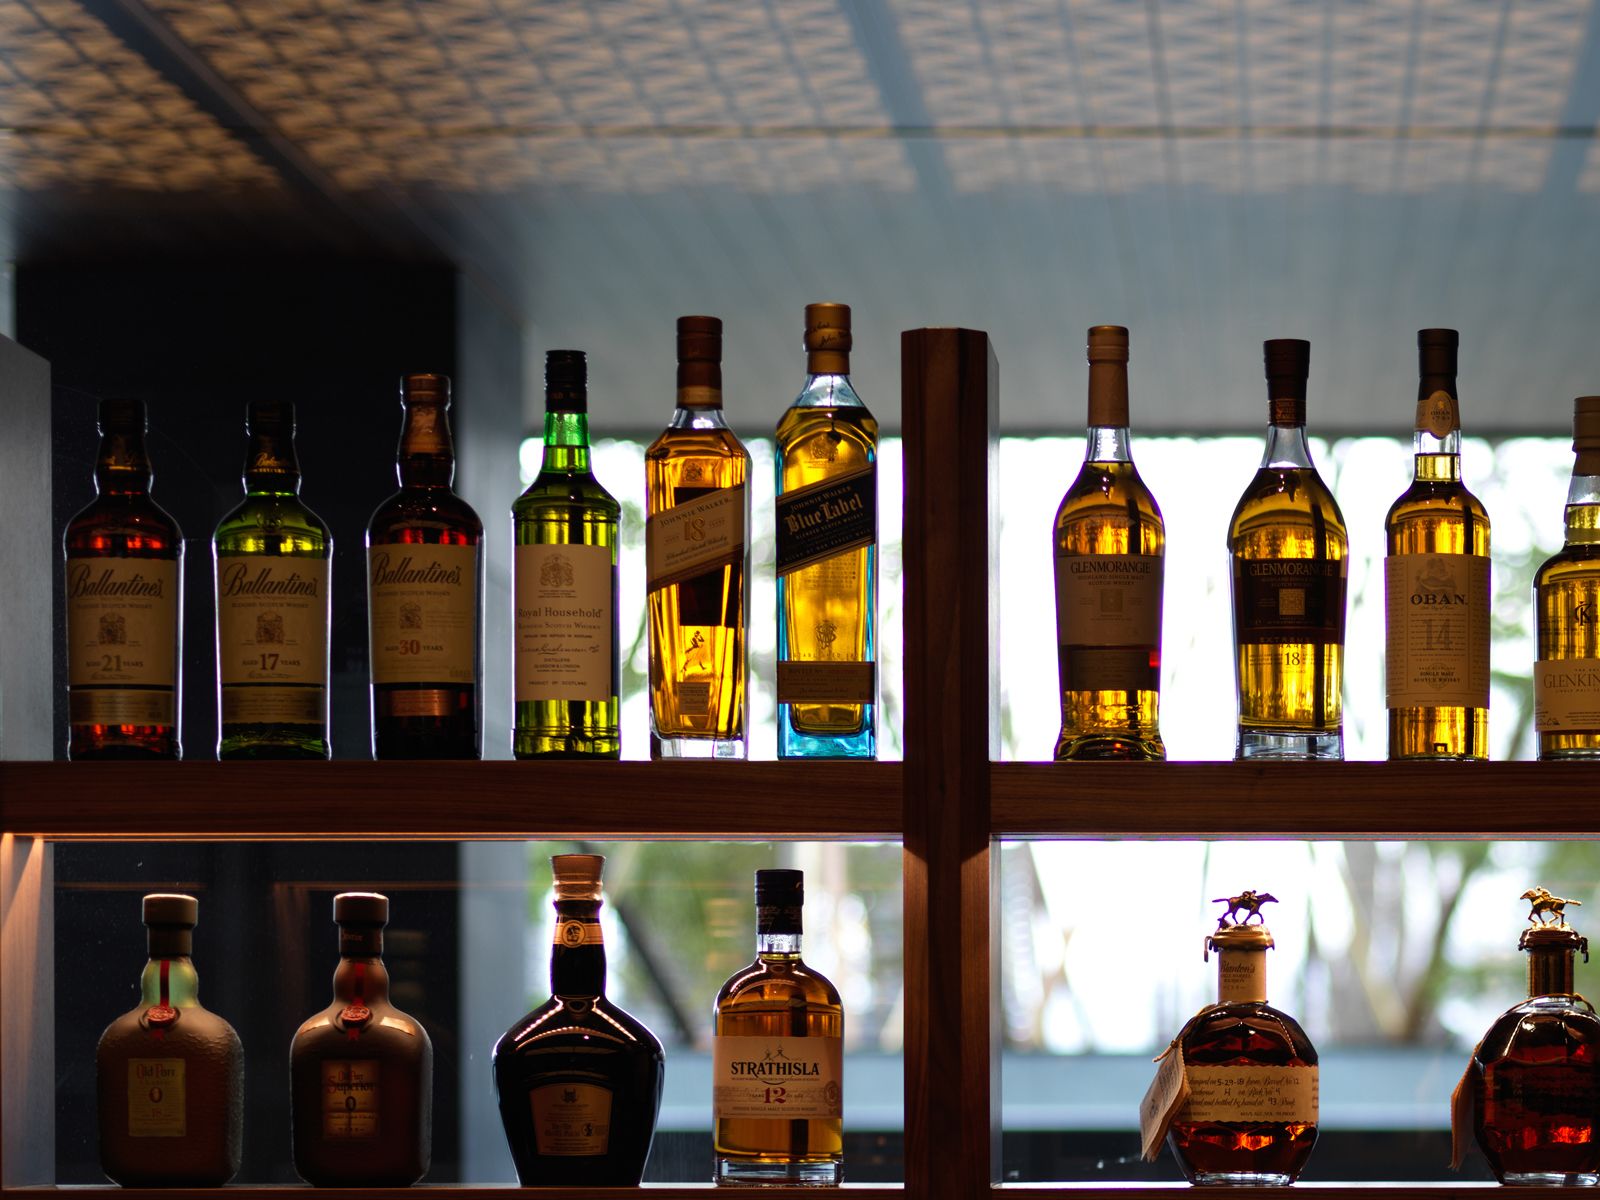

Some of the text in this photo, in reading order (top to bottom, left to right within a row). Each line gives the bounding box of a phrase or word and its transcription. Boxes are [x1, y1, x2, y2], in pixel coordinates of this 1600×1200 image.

[783, 492, 864, 536] Blue Label
[371, 551, 462, 587] Ballantine's
[1071, 560, 1152, 575] GLENMORANGIE
[1250, 562, 1333, 576] GLENMORANGIE
[70, 563, 164, 598] Ballantine's
[222, 562, 319, 598] Ballantine's
[1410, 592, 1467, 606] OBAN
[545, 607, 602, 618] Household
[399, 640, 420, 656] 30
[101, 654, 122, 671] 21
[259, 654, 280, 671] 17
[1284, 651, 1300, 666] 18
[730, 1061, 820, 1079] STRATHISLA
[764, 1087, 787, 1104] 12
